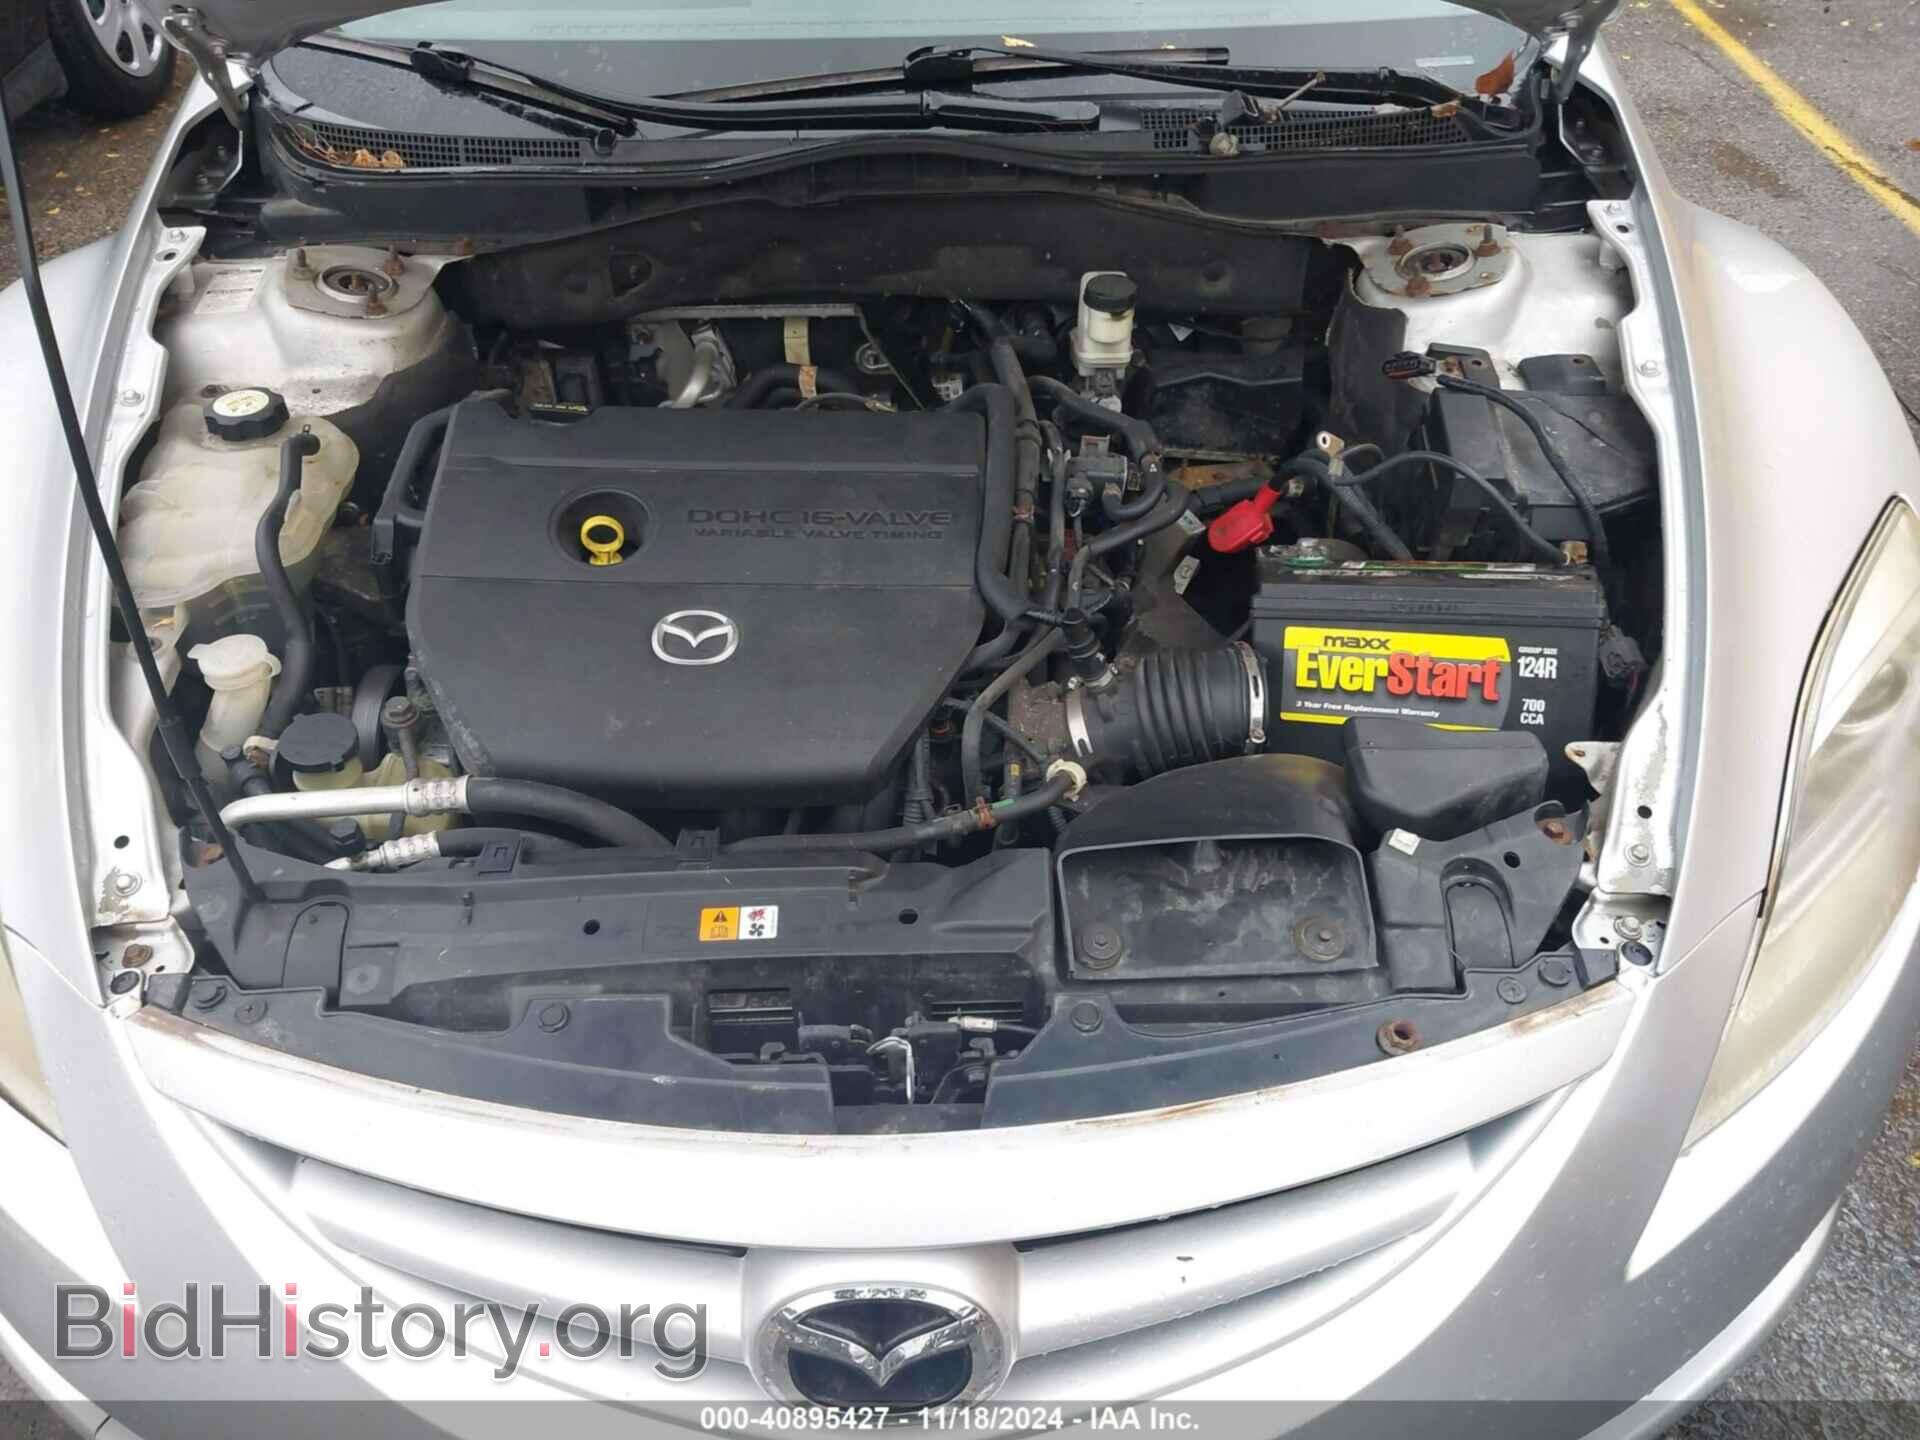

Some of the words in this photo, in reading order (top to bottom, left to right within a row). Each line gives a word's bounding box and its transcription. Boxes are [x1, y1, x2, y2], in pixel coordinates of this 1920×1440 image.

[688, 509, 793, 524] DOHC
[802, 511, 951, 526] 16-VALVE
[695, 528, 796, 538] VARIABLE
[801, 529, 864, 540] VALVE
[871, 530, 944, 540] TIMING
[1323, 635, 1391, 650] maxx
[1295, 646, 1501, 701] EverStart
[1517, 655, 1558, 679] 124R
[1304, 701, 1321, 709] Year
[1323, 702, 1342, 710] Free
[1344, 703, 1400, 714] Replacement
[1401, 708, 1440, 718] Warranty
[1521, 698, 1546, 712] 700
[1520, 712, 1544, 725] CCA
